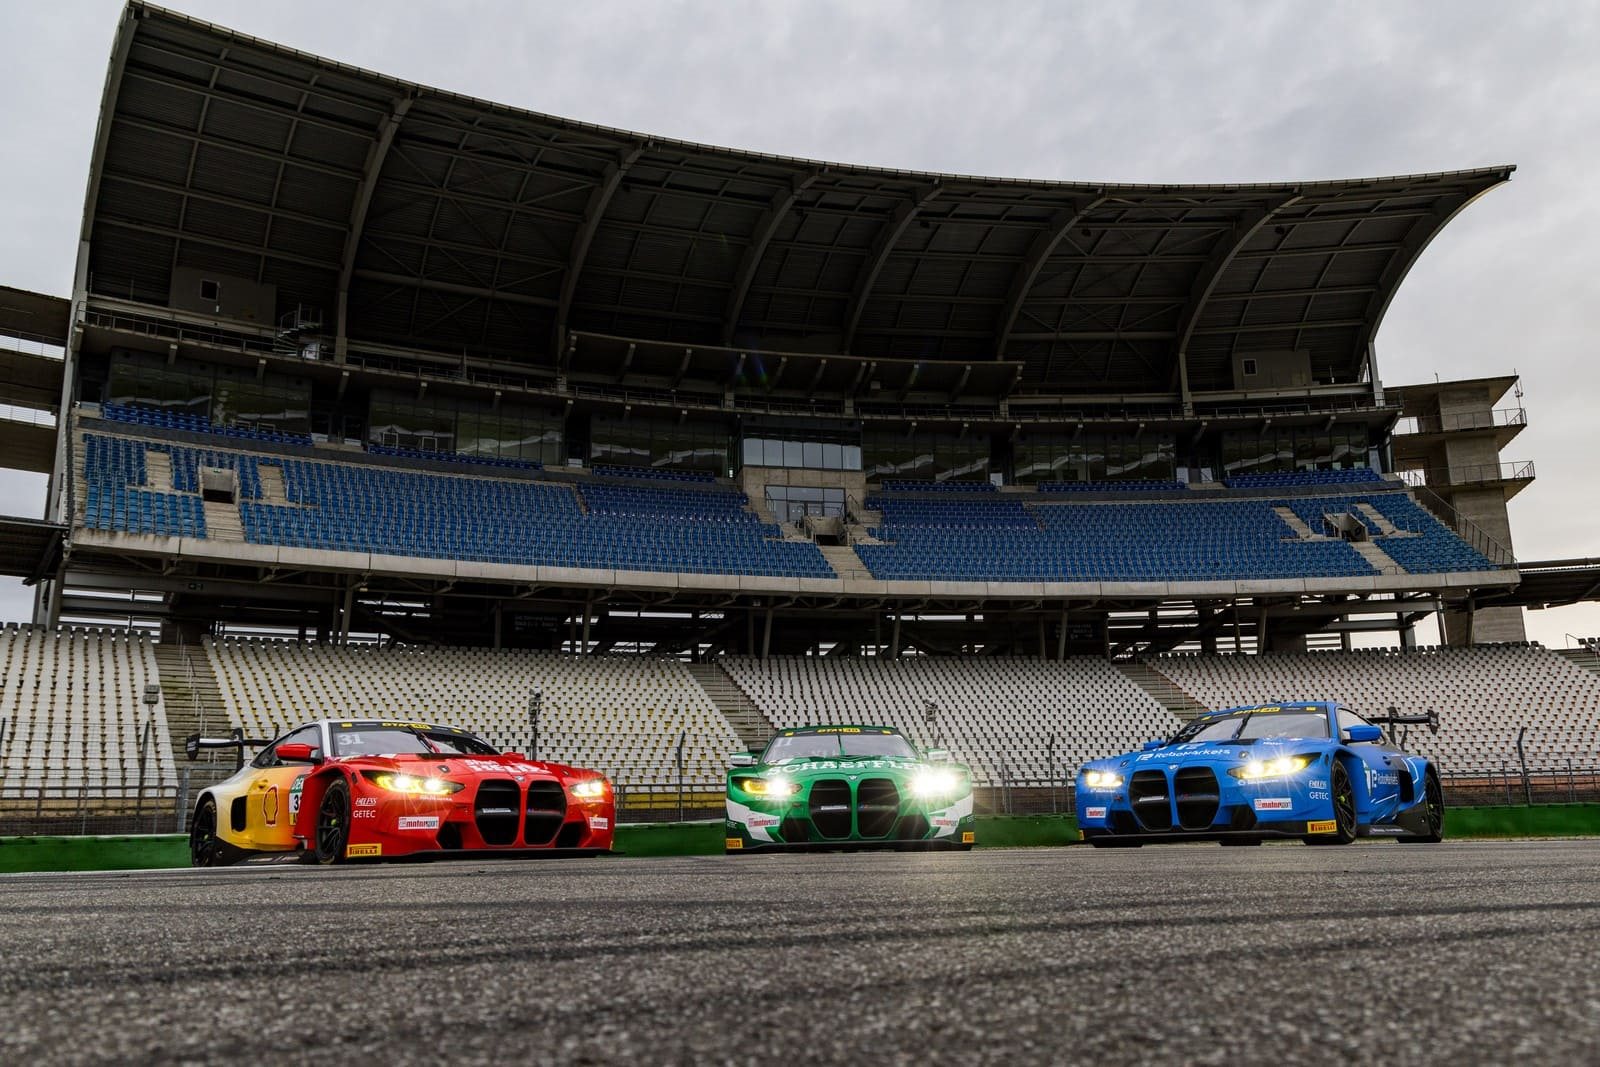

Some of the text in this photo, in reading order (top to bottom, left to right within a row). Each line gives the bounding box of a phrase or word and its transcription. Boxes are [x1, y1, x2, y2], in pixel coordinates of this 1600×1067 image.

[339, 733, 364, 745] 31
[1309, 791, 1329, 801] GETEC
[353, 809, 377, 818] GETEC
